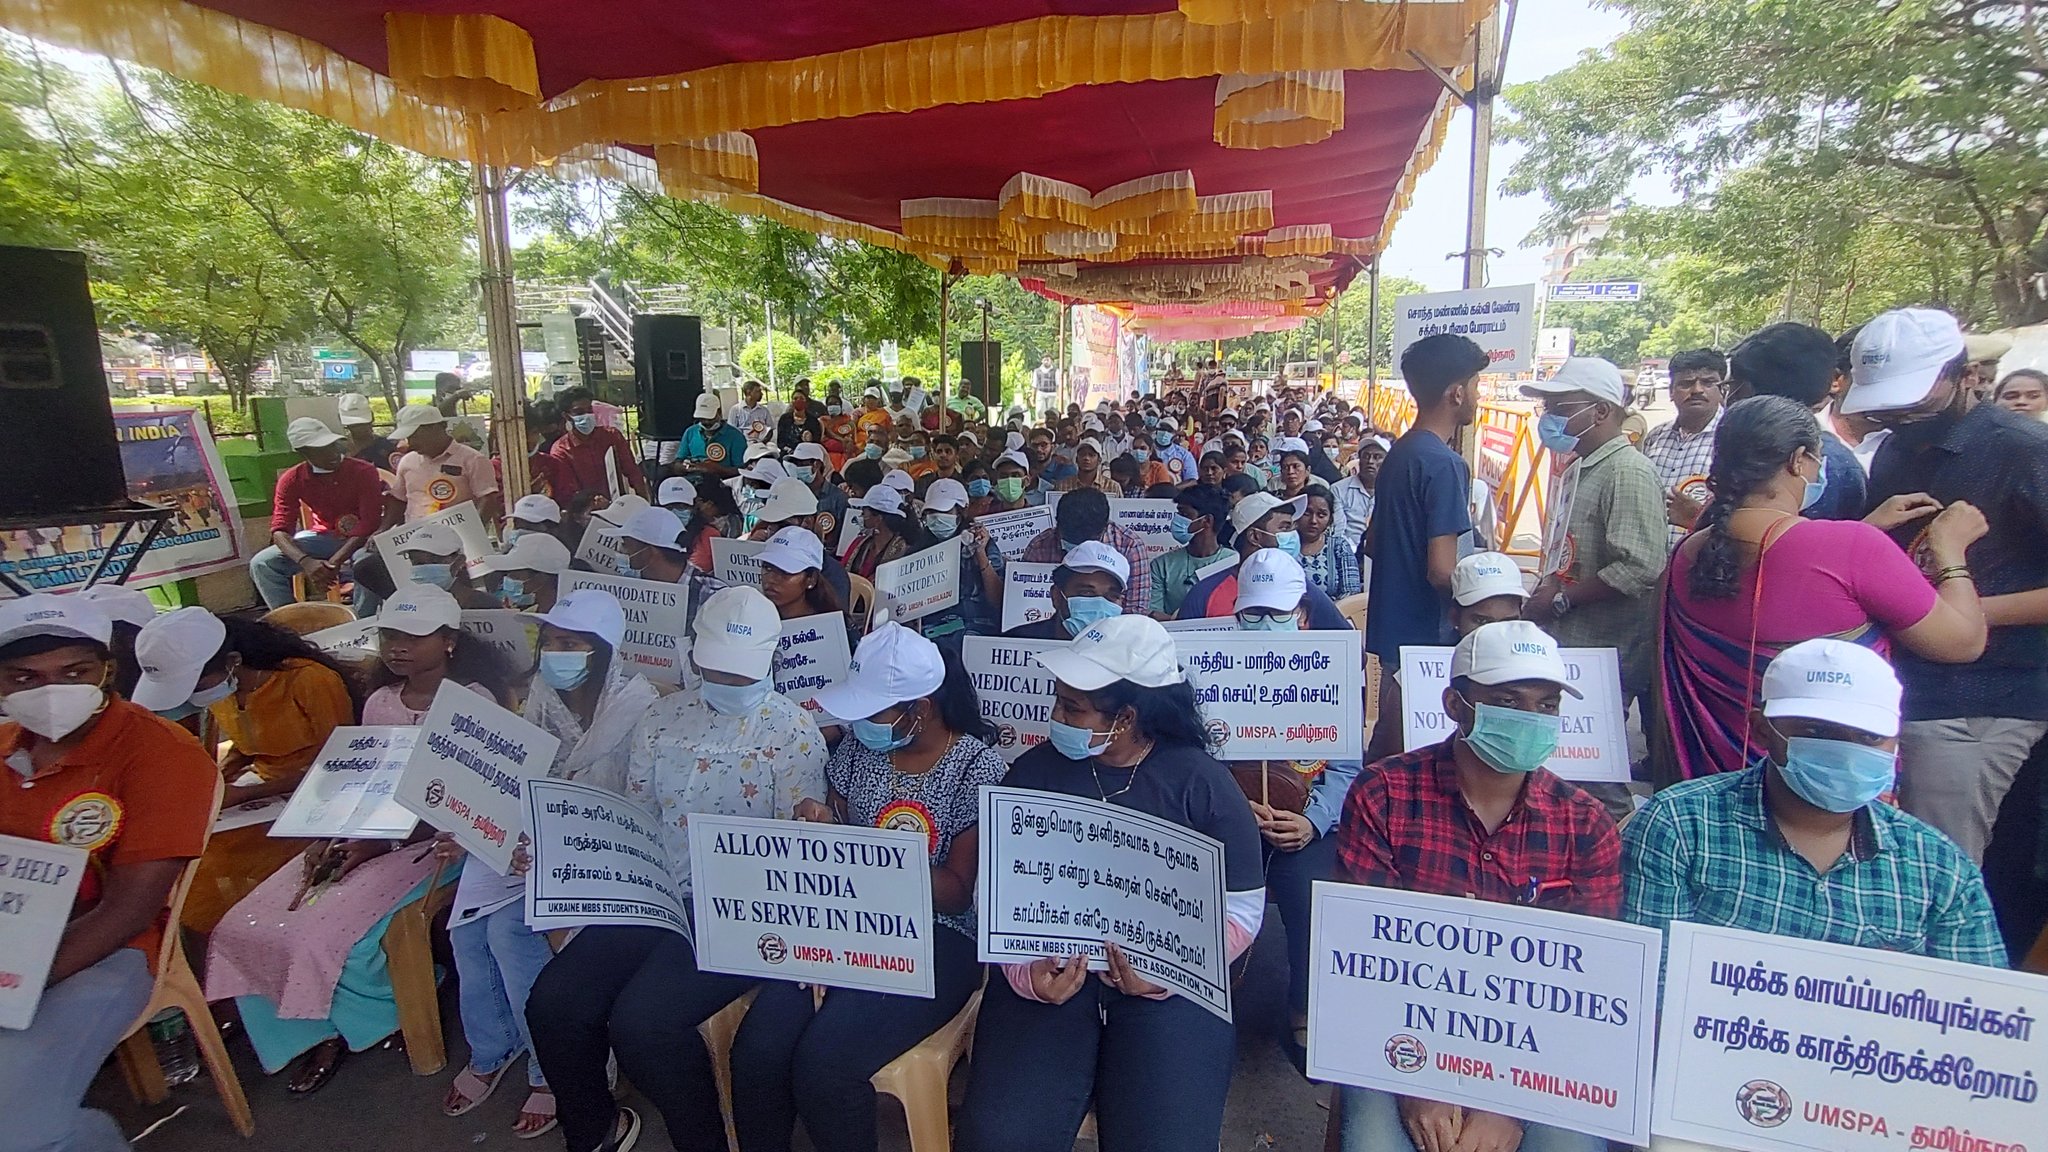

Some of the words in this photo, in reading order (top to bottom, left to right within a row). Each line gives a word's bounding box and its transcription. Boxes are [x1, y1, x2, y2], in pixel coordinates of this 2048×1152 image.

[128, 424, 182, 442] INDIA
[19, 551, 86, 571] STUDENTS
[147, 528, 220, 550] SSOCIATION
[586, 548, 615, 569] SAFE
[730, 553, 750, 566] OUR
[726, 570, 738, 581] IN
[1251, 574, 1274, 583] UMSPA
[1477, 567, 1502, 576] UMSPA
[662, 593, 676, 607] US
[472, 621, 493, 634] TO
[726, 622, 752, 636] UMSPA
[1514, 643, 1547, 657] UMSPA
[1244, 651, 1285, 674] மாநில
[1289, 650, 1331, 672] அரசே
[1419, 661, 1445, 679] WE
[971, 672, 1042, 695] MEDICAL
[1806, 671, 1851, 685] UMSPA
[1260, 685, 1298, 708] உதவி
[982, 700, 1049, 722] BECOME
[1414, 712, 1446, 730] NOT
[1236, 726, 1277, 739] UMSPA
[1286, 723, 1338, 743] தமிழ்நாடு
[445, 794, 471, 821] UMSPA
[1011, 805, 1084, 844] இன்னுமொரு
[1087, 820, 1151, 854] அனிதாவாக
[1153, 840, 1199, 872] உருவாக
[713, 832, 791, 860] ALLOW
[797, 838, 827, 863] TO
[834, 841, 907, 870] STUDY
[11, 857, 69, 885] HELP
[552, 863, 612, 884] எதிர்காலம்
[1013, 858, 1055, 885] கூடாது
[1058, 859, 1090, 889] என்று
[1094, 867, 1142, 898] உக்ரைன்
[765, 869, 788, 893] IN
[794, 871, 858, 899] INDIA
[548, 902, 580, 912] UKRAINE
[581, 903, 601, 913] MBBS
[712, 897, 747, 922] WE
[752, 900, 820, 930] SERVE
[826, 907, 849, 932] IN
[855, 911, 919, 940] INDIA
[1073, 907, 1110, 936] என்றே
[1371, 914, 1503, 957] RECOUP
[1510, 935, 1585, 973] OUR
[793, 945, 834, 964] UMSPA
[844, 950, 915, 974] TAMILNADU
[1003, 938, 1041, 952] UKRAINE
[1042, 941, 1065, 954] MBBS
[1202, 988, 1214, 1000] TN
[1331, 950, 1477, 997] MEDICAL
[1484, 974, 1628, 1026] STUDIES
[1710, 960, 1788, 997] படிக்க
[1794, 975, 2036, 1042] வாய்ப்பளியுங்கள்
[1403, 1002, 1436, 1032] IN
[1446, 1009, 1540, 1054] INDIA
[1693, 1015, 1790, 1054] சாதிக்க
[1796, 1033, 2039, 1104] காத்திருக்கிறோம்
[1436, 1052, 1494, 1081] UMSPA
[1510, 1067, 1618, 1108] TAMILNADU
[1803, 1100, 1889, 1138] UMSPA
